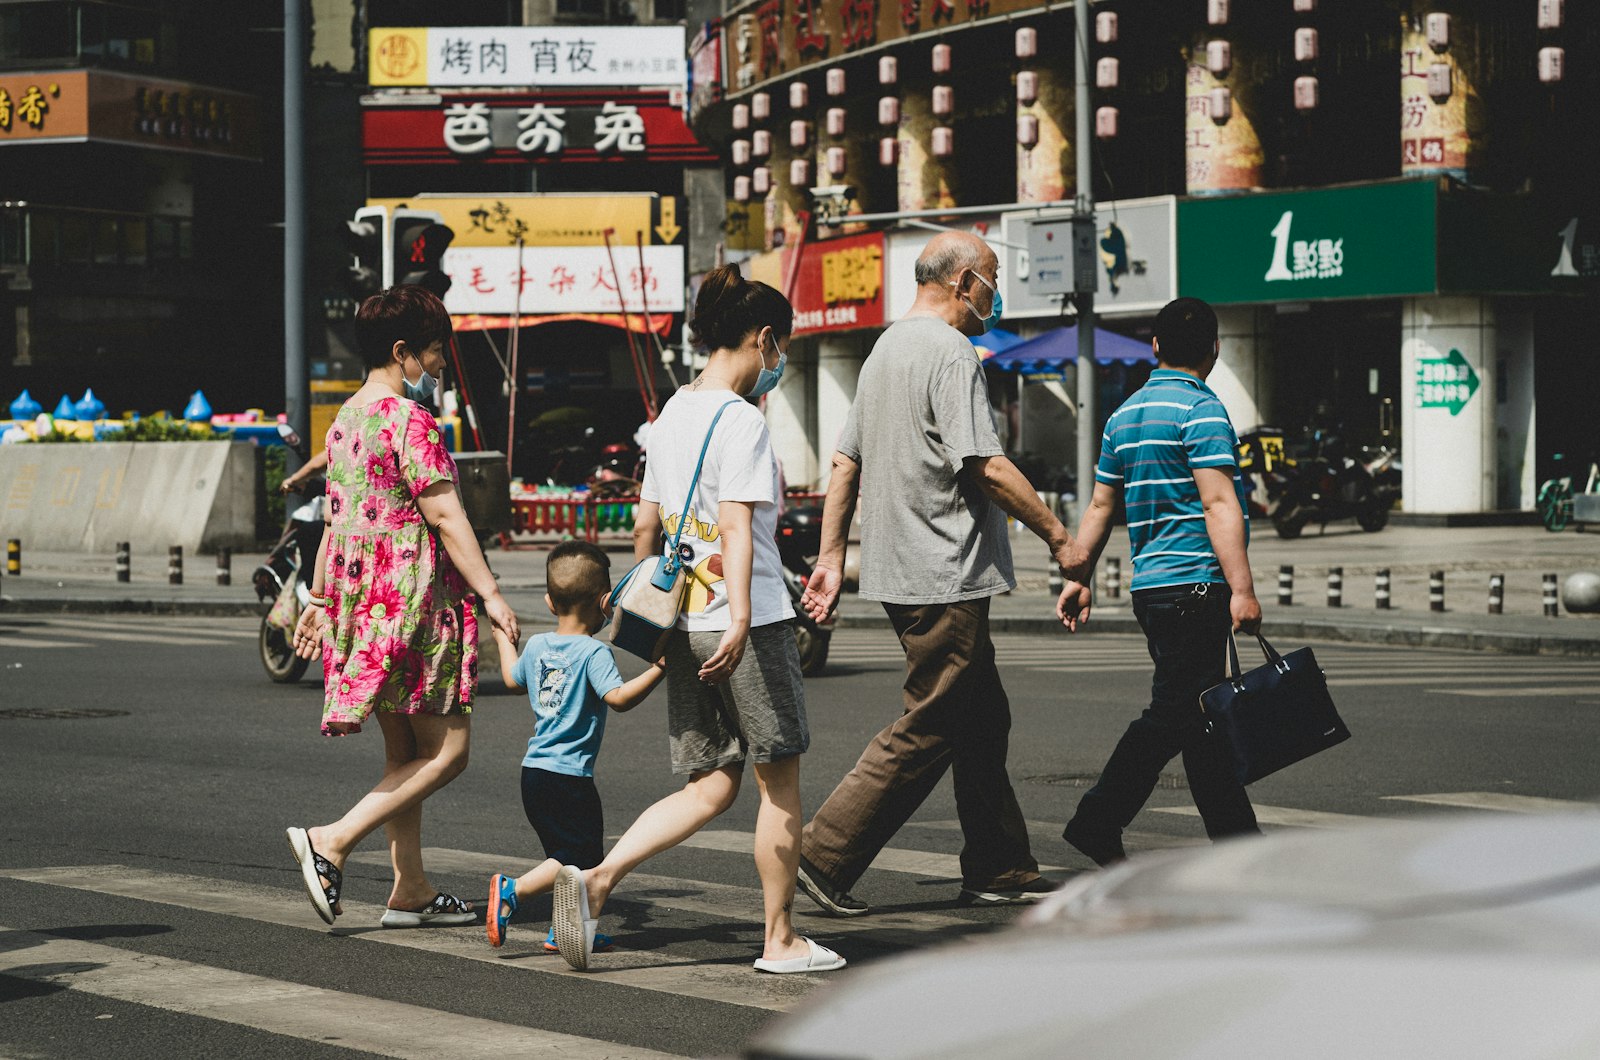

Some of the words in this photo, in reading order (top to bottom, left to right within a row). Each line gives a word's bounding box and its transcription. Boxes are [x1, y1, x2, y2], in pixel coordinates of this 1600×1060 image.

[440, 37, 508, 74] 烤肉
[530, 38, 598, 74] 宵夜
[443, 101, 646, 154] 芭夯兔
[447, 265, 658, 295] 毛牛杂火锅
